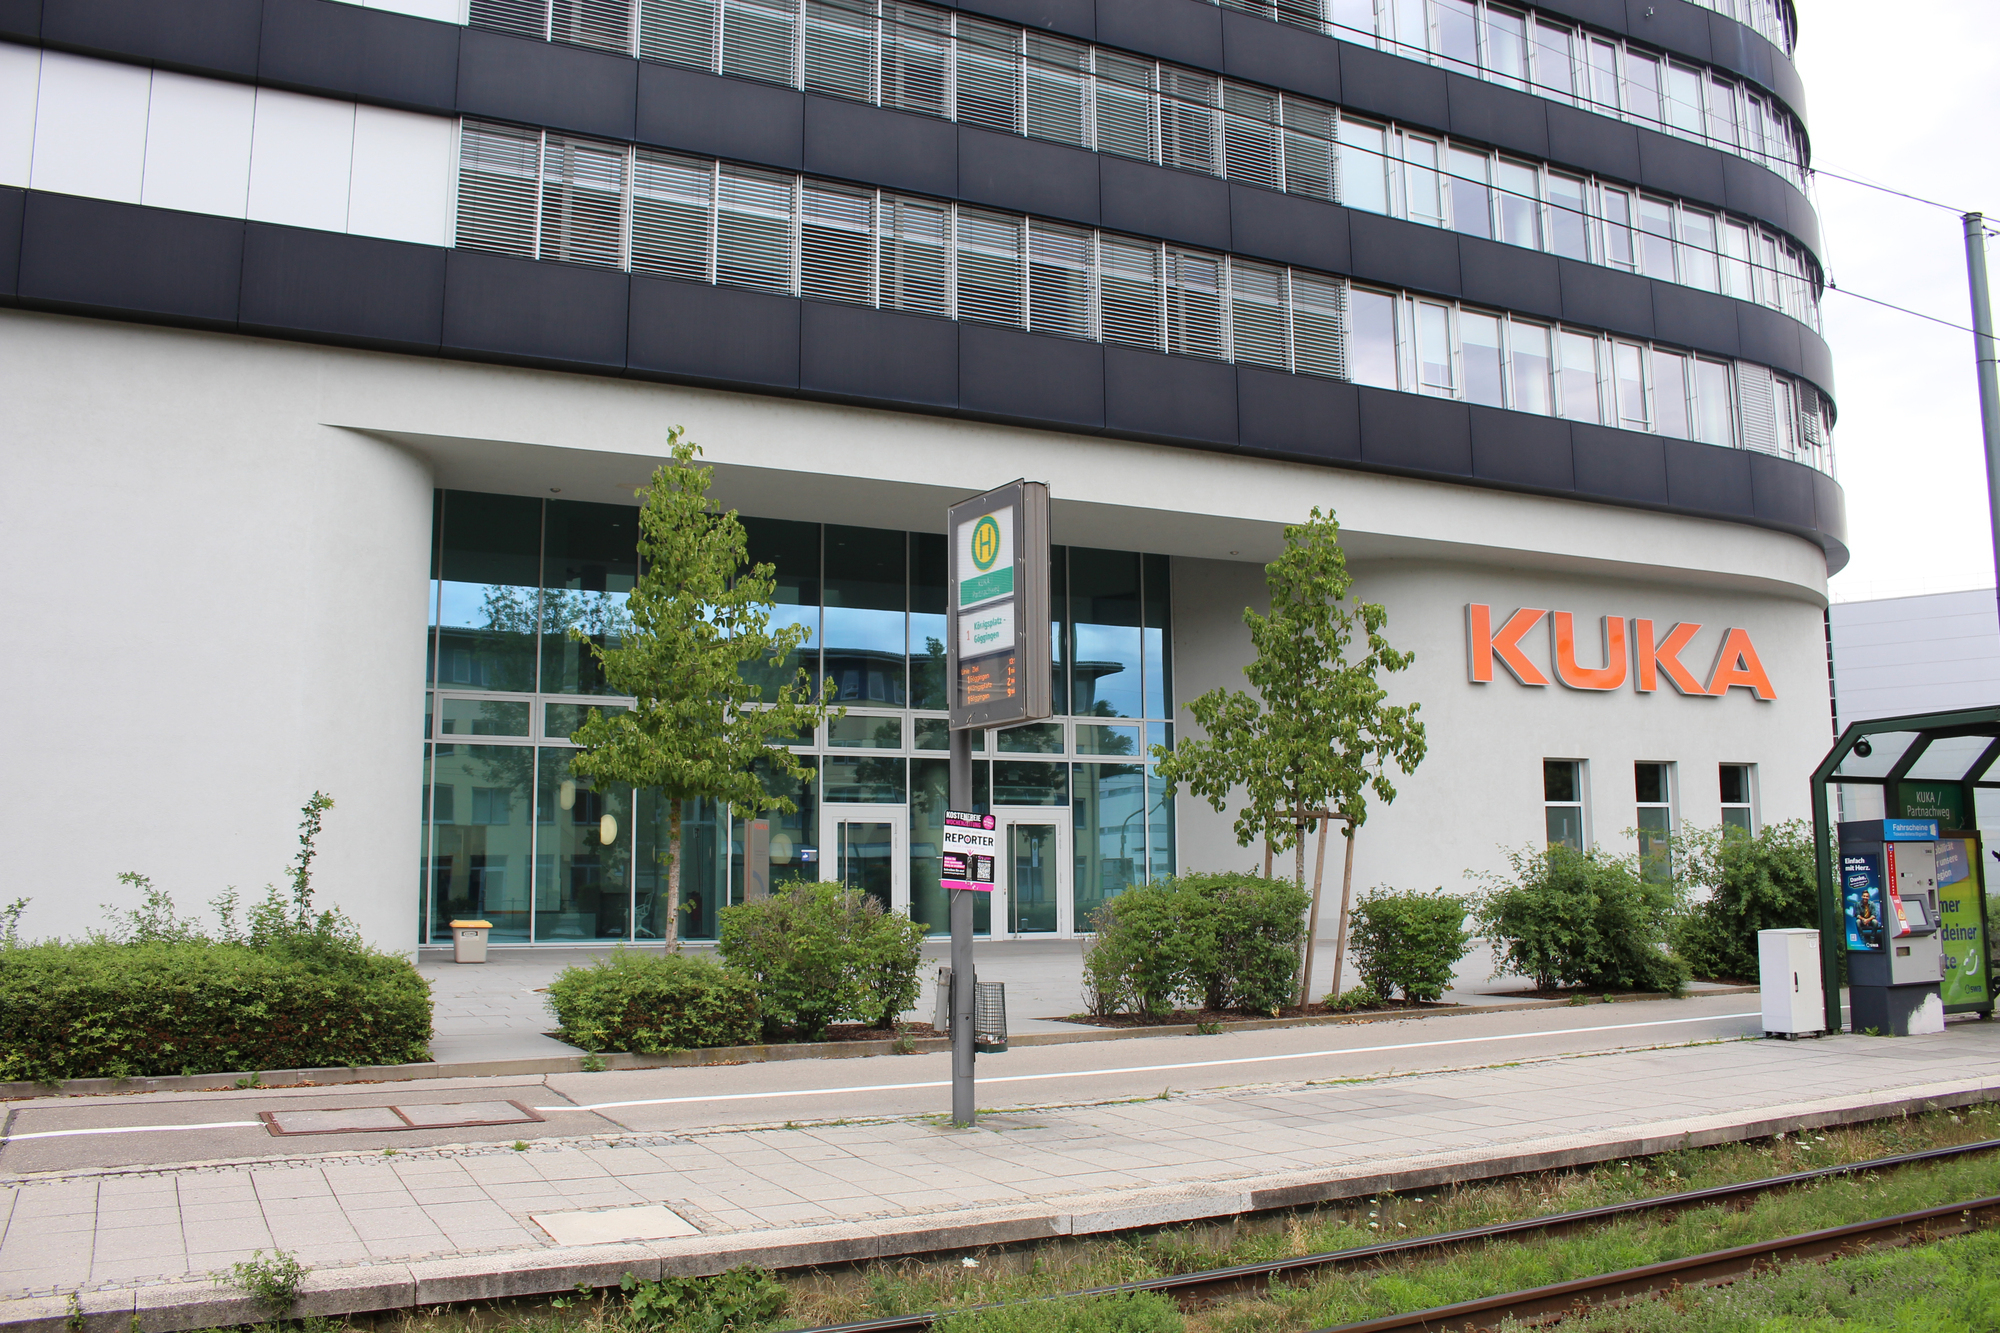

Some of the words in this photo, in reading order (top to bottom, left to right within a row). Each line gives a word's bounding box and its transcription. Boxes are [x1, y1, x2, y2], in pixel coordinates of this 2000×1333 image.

[980, 527, 991, 559] H
[974, 617, 1002, 630] Königsplatz
[967, 630, 970, 640] 1
[974, 631, 999, 643] Göggingen
[1465, 603, 1778, 701] KUKA
[1916, 791, 1935, 803] KUKA
[1907, 805, 1950, 819] Partnachweg
[1892, 823, 1929, 832] Fahrscheine
[945, 832, 994, 846] REPORTER
[1940, 854, 1958, 866] unsere
[1942, 923, 1977, 941] deiner
